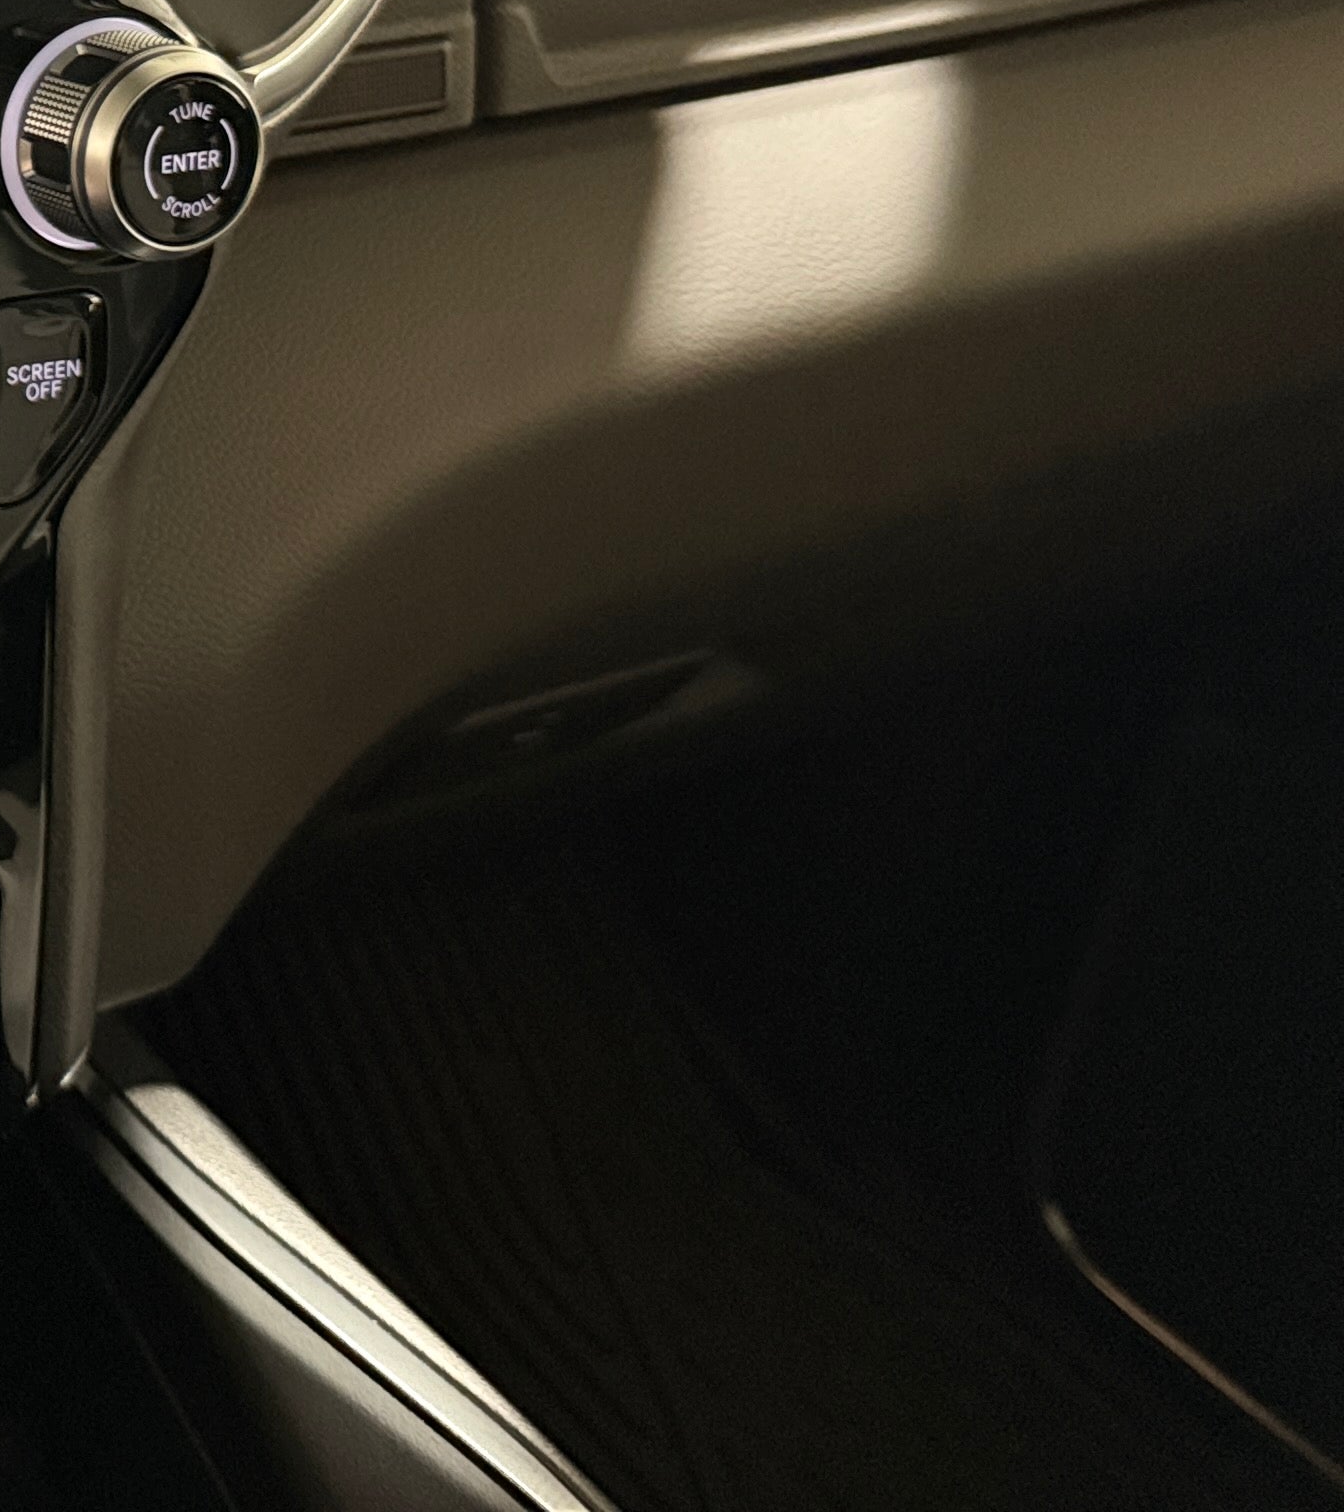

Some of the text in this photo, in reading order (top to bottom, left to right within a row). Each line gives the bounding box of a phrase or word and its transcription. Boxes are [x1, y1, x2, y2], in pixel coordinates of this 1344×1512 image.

[169, 102, 214, 122] TUNE
[161, 149, 221, 175] ENTER
[161, 193, 221, 220] SCROLL
[7, 359, 81, 386] SCREEN
[26, 379, 62, 402] OFF
